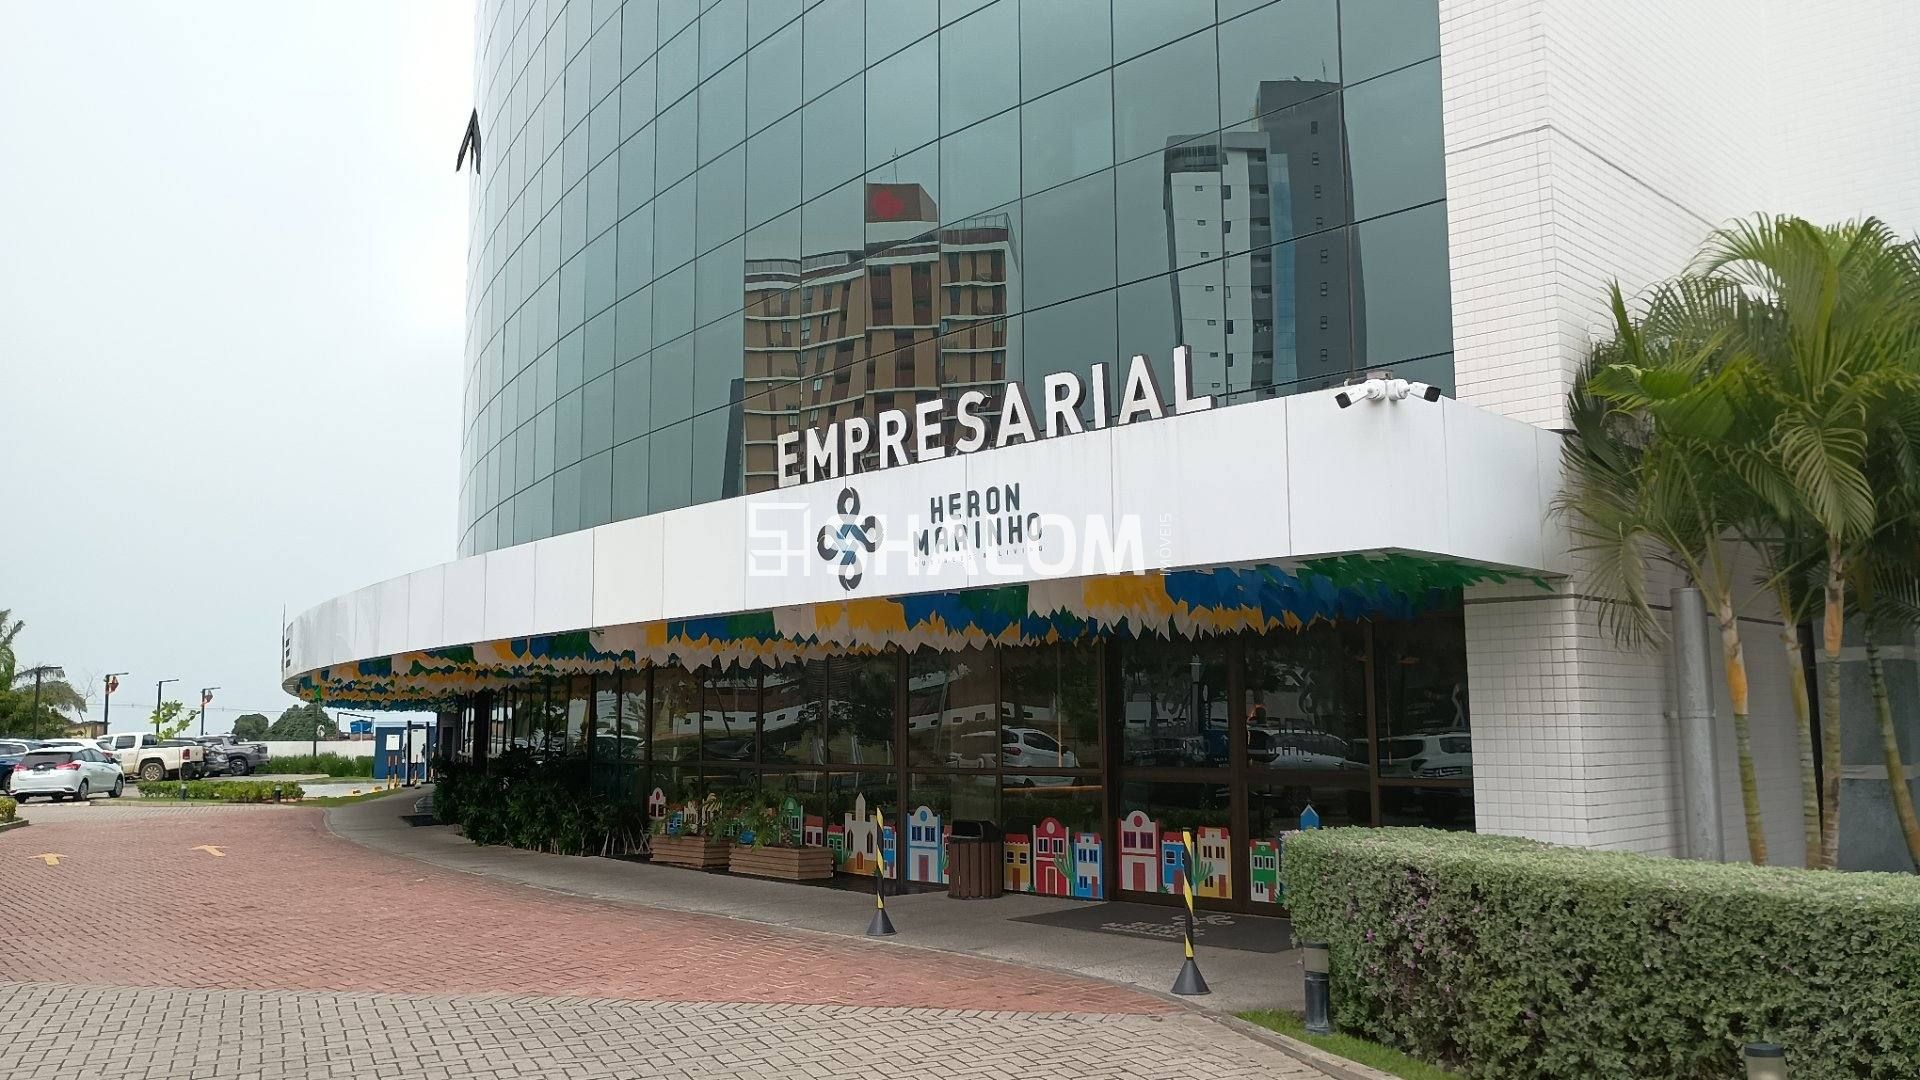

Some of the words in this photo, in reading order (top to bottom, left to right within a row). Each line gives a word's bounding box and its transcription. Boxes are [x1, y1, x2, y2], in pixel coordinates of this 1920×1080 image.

[777, 345, 1217, 488] EMPRESARIAL
[930, 482, 1020, 524] HERON
[912, 512, 1043, 557] MARINHO
